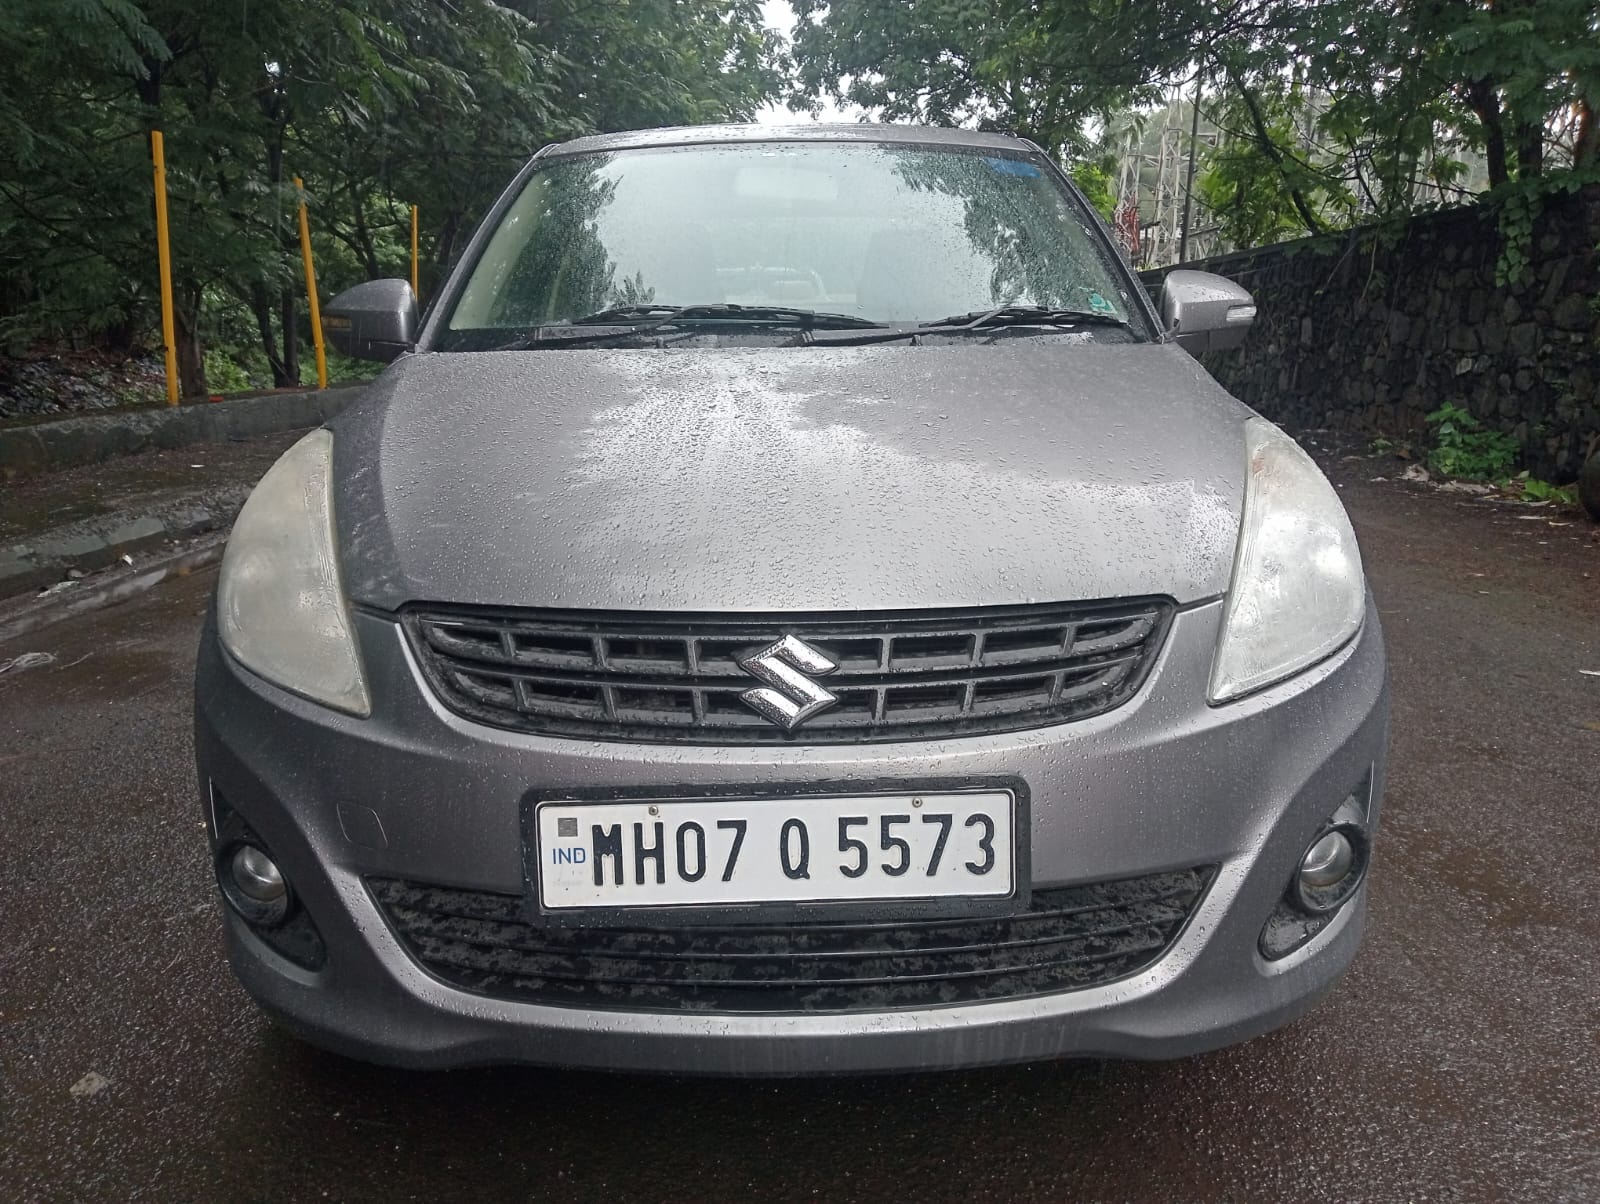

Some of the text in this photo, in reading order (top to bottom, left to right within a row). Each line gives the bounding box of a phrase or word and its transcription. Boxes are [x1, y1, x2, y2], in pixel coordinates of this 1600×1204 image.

[552, 847, 586, 865] IND
[591, 813, 995, 887] MH07 Q 5573
